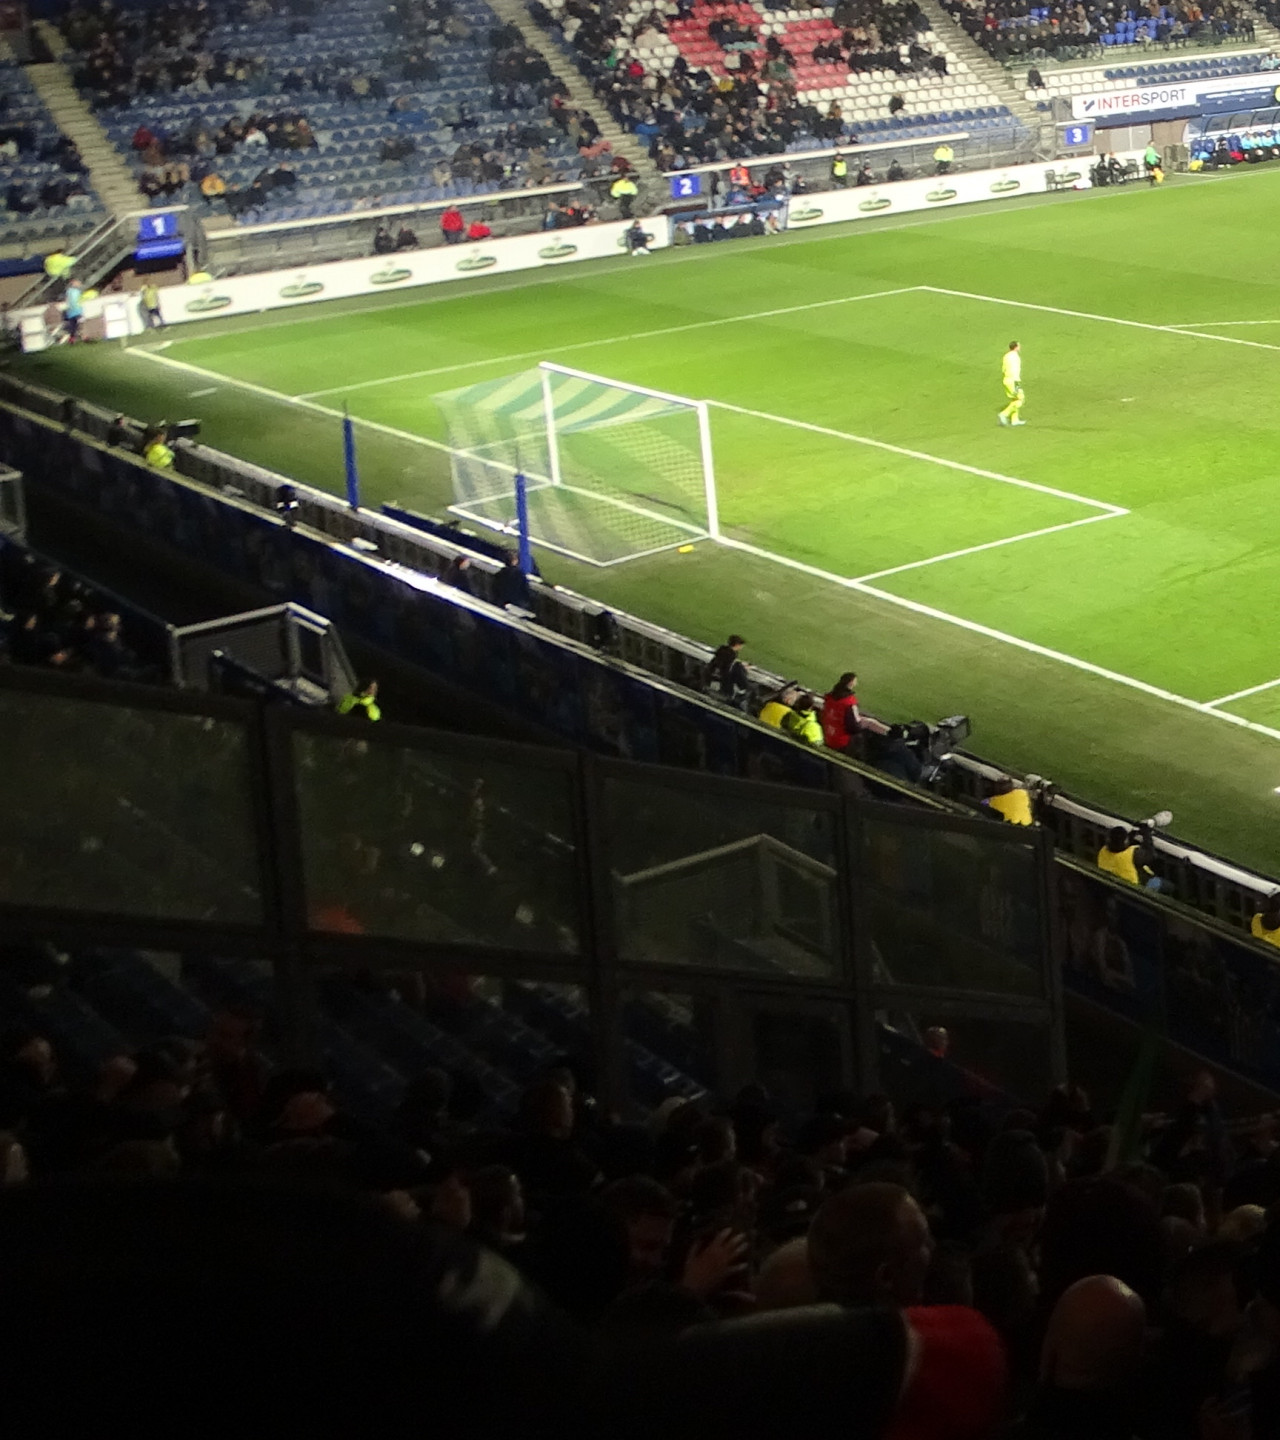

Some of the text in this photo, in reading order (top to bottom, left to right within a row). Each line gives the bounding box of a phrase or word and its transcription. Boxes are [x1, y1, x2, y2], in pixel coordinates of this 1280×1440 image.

[1098, 88, 1187, 111] INTERSPORT
[1072, 128, 1083, 143] 3
[680, 179, 693, 196] 2
[152, 217, 165, 235] 1
